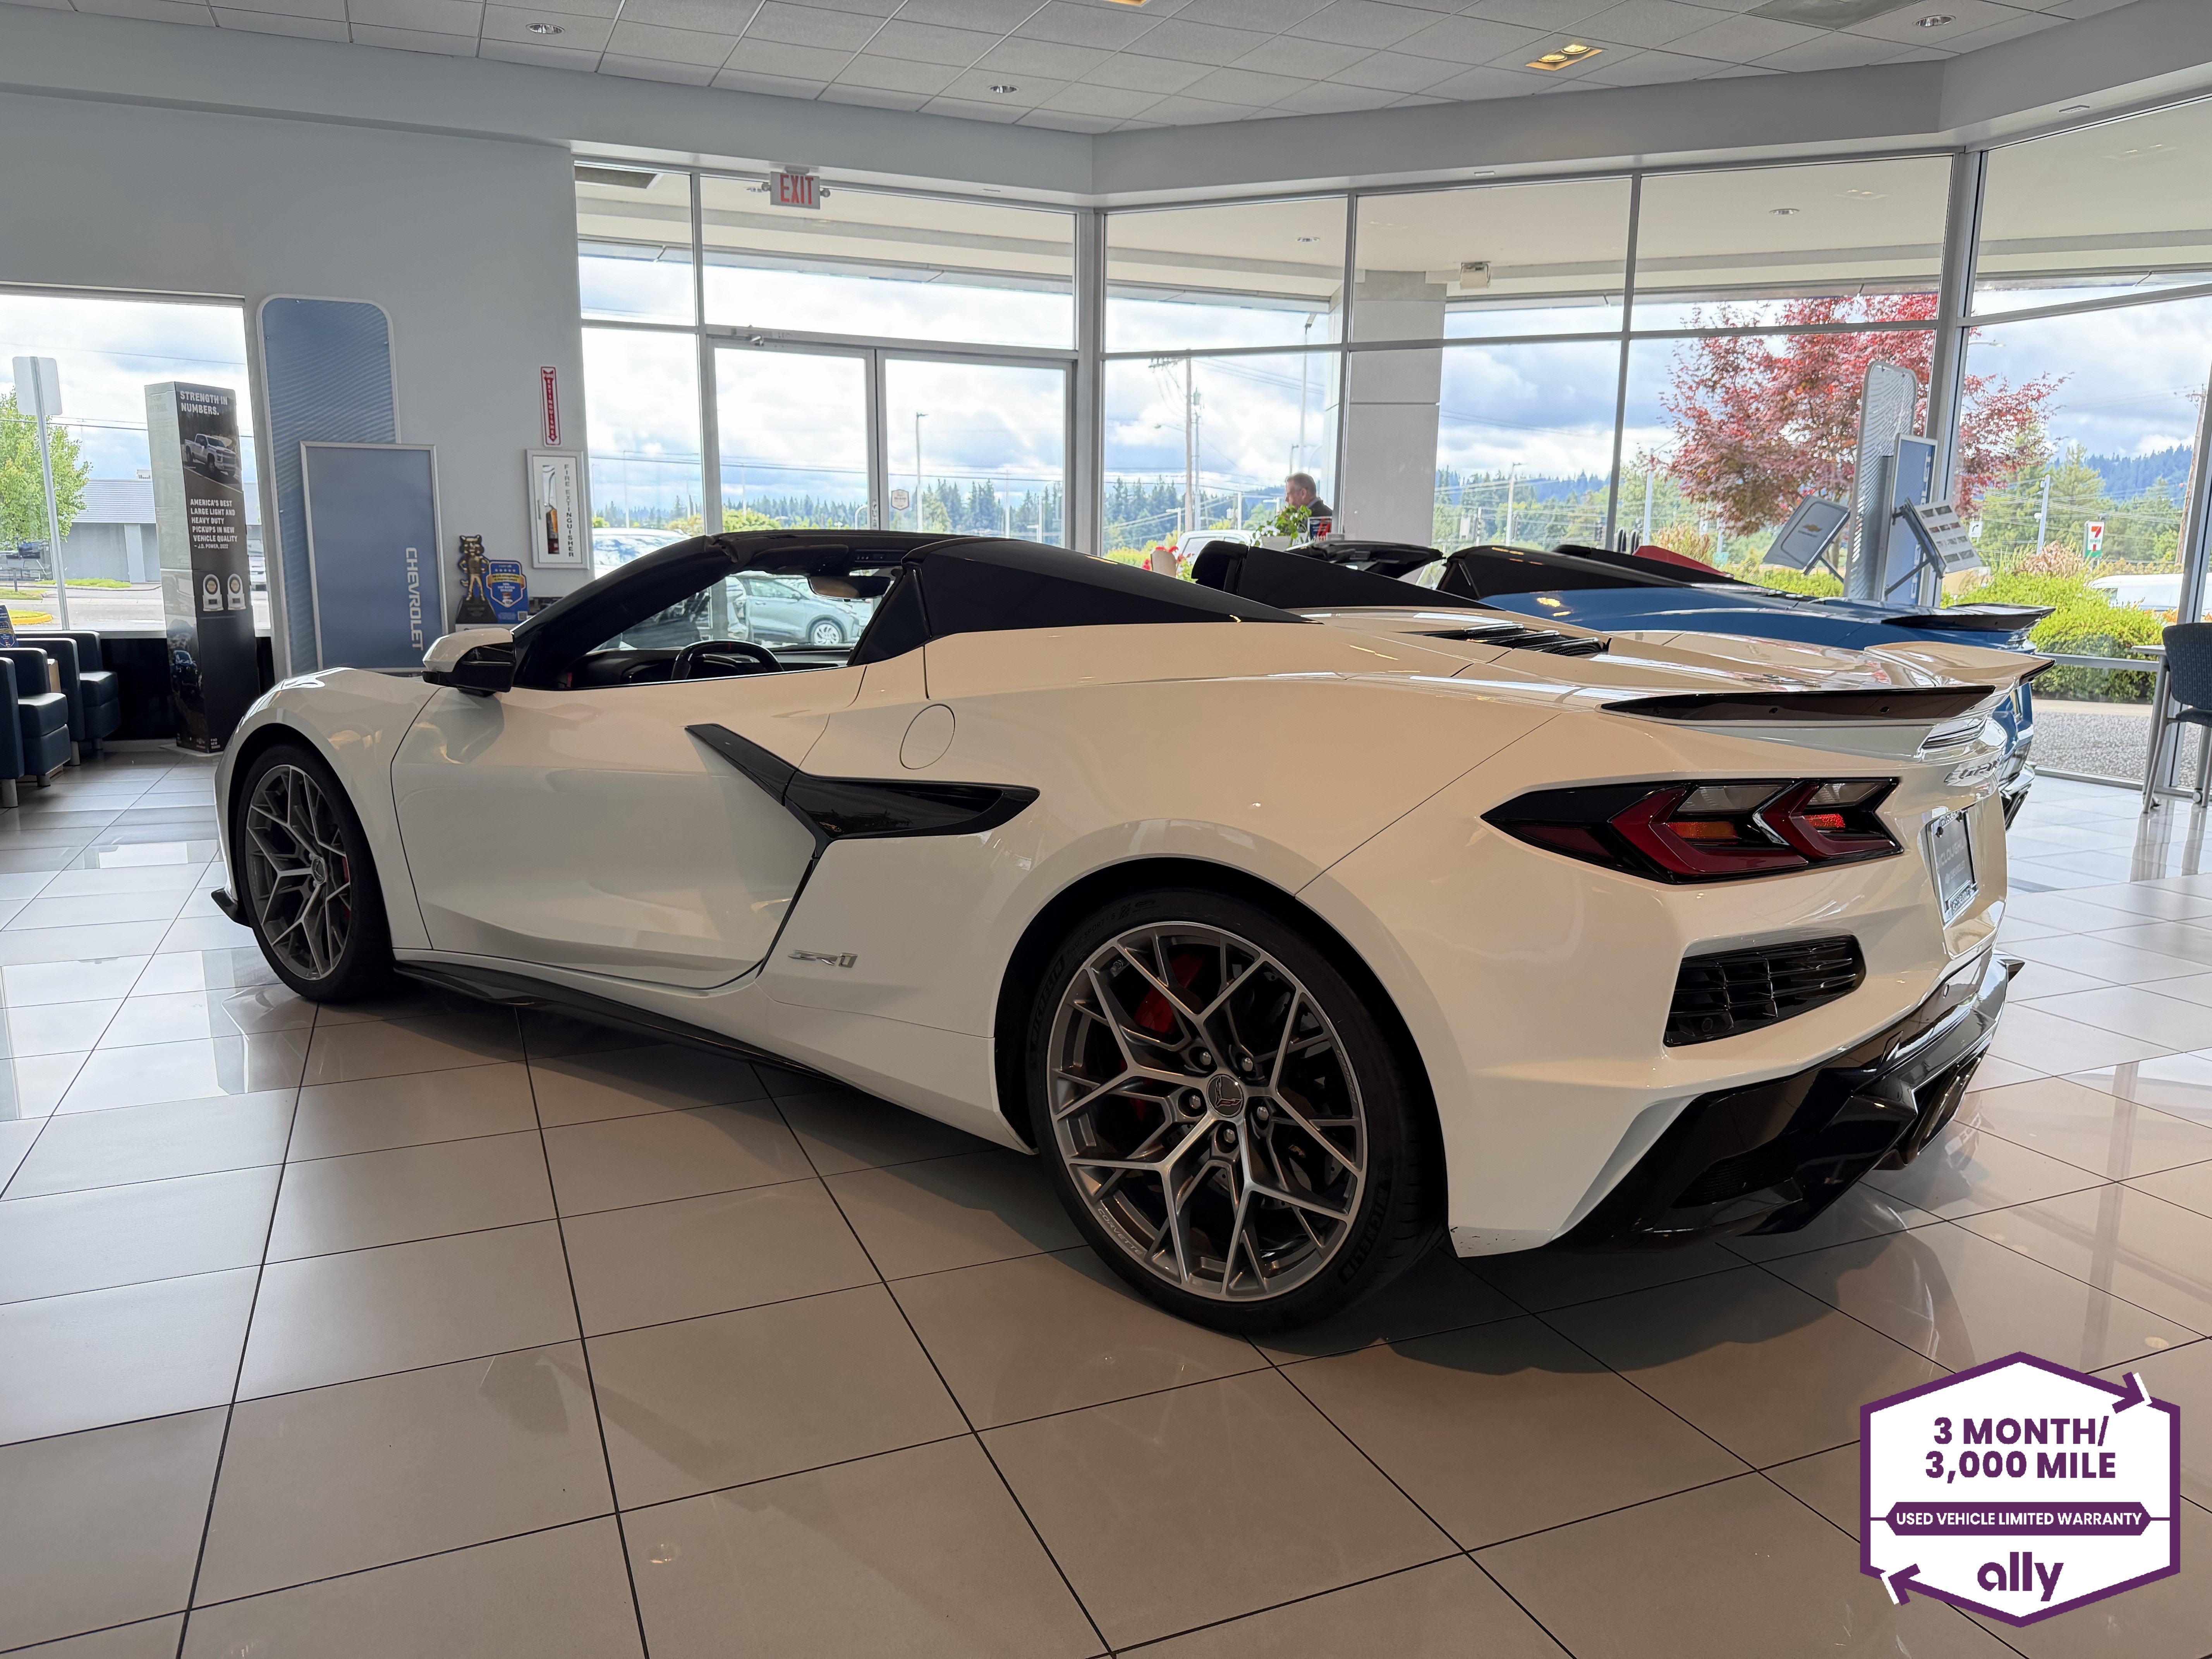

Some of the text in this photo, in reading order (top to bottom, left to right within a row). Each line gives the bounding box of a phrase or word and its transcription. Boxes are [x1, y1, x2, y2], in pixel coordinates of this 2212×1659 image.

[780, 173, 814, 205] EXIT
[180, 391, 228, 405] STRENGTH IN
[181, 402, 219, 416] NUMBERS.
[190, 499, 219, 507] AMERICA'S
[565, 489, 574, 557] EXTINGUISHER
[405, 547, 424, 651] CHEVROLET
[1084, 919, 1104, 936] SPORT
[1032, 958, 1064, 1041] MICHELIN
[1097, 1208, 1143, 1255] CORVETTE
[1342, 1187, 1388, 1279] MICHELIN
